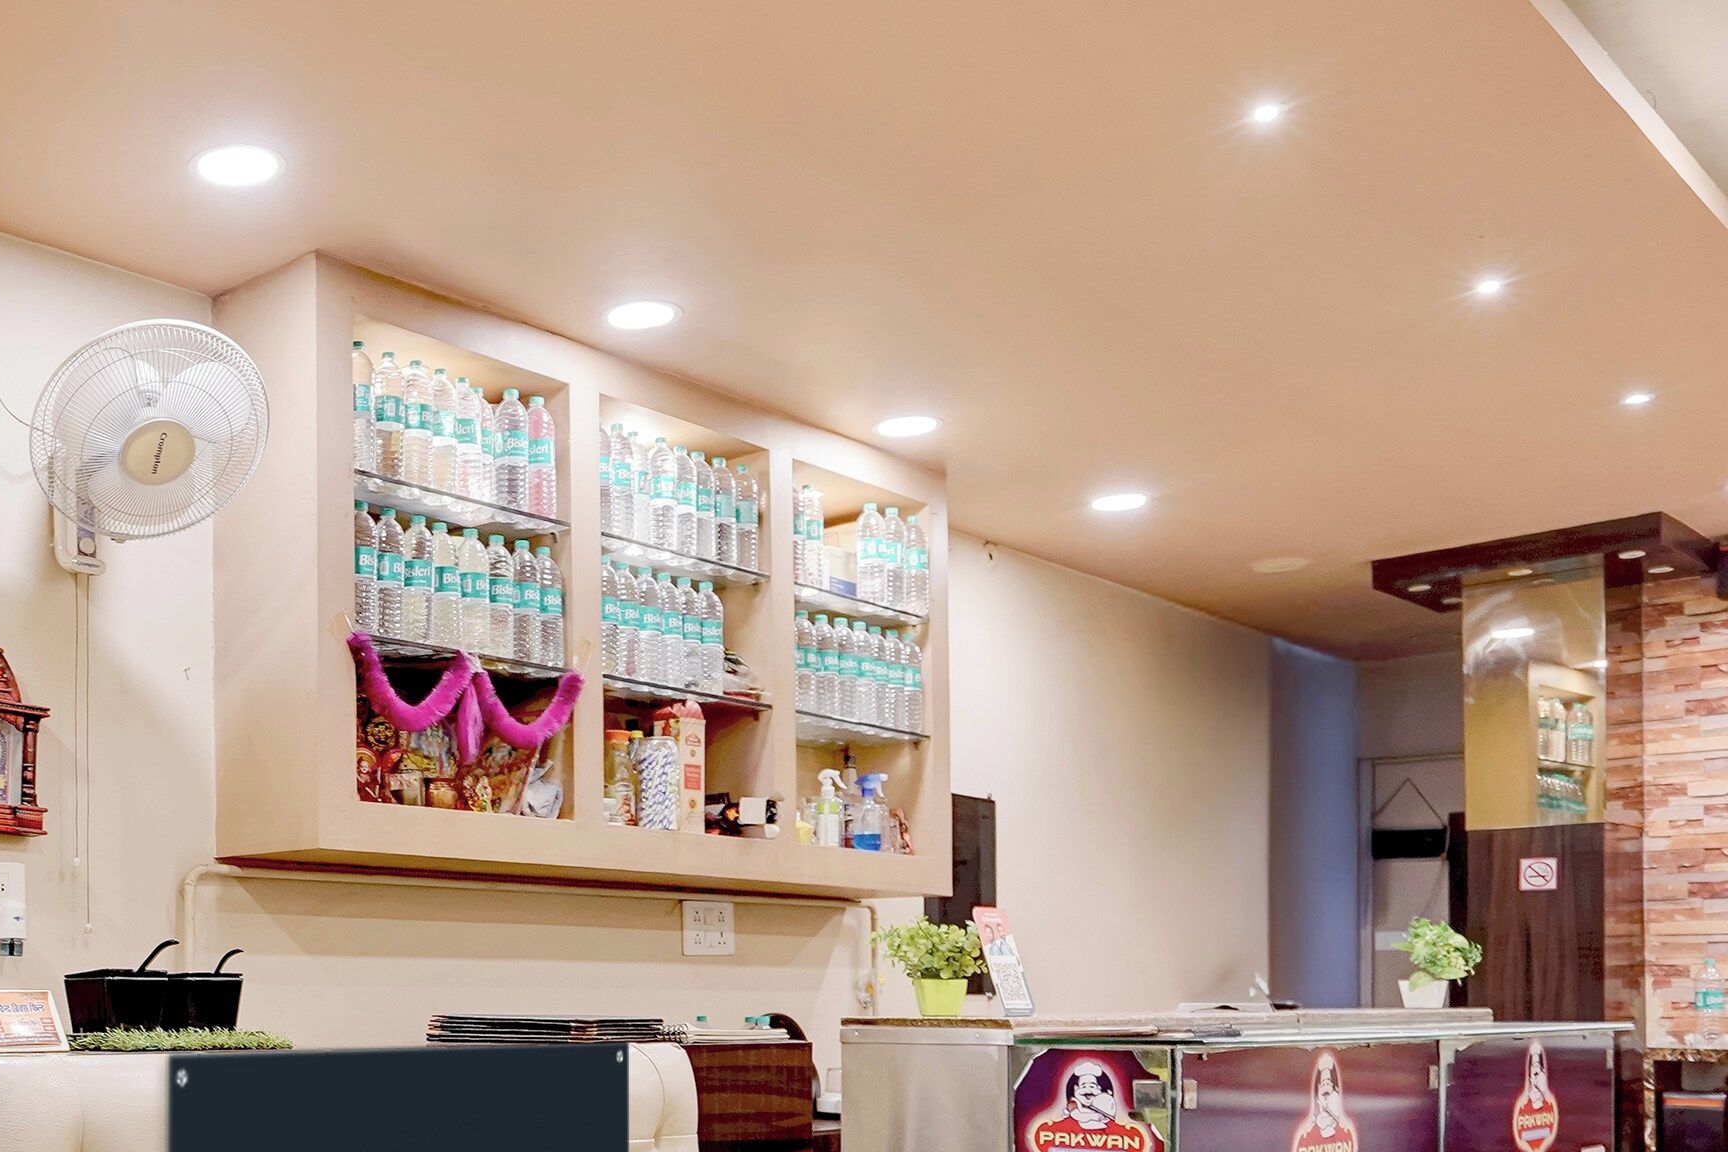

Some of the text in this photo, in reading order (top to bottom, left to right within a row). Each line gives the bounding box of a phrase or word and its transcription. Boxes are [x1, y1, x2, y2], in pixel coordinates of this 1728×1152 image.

[151, 432, 168, 475] Crompton
[1518, 1112, 1554, 1130] PAKWAN
[1039, 1131, 1140, 1150] PAKWAN
